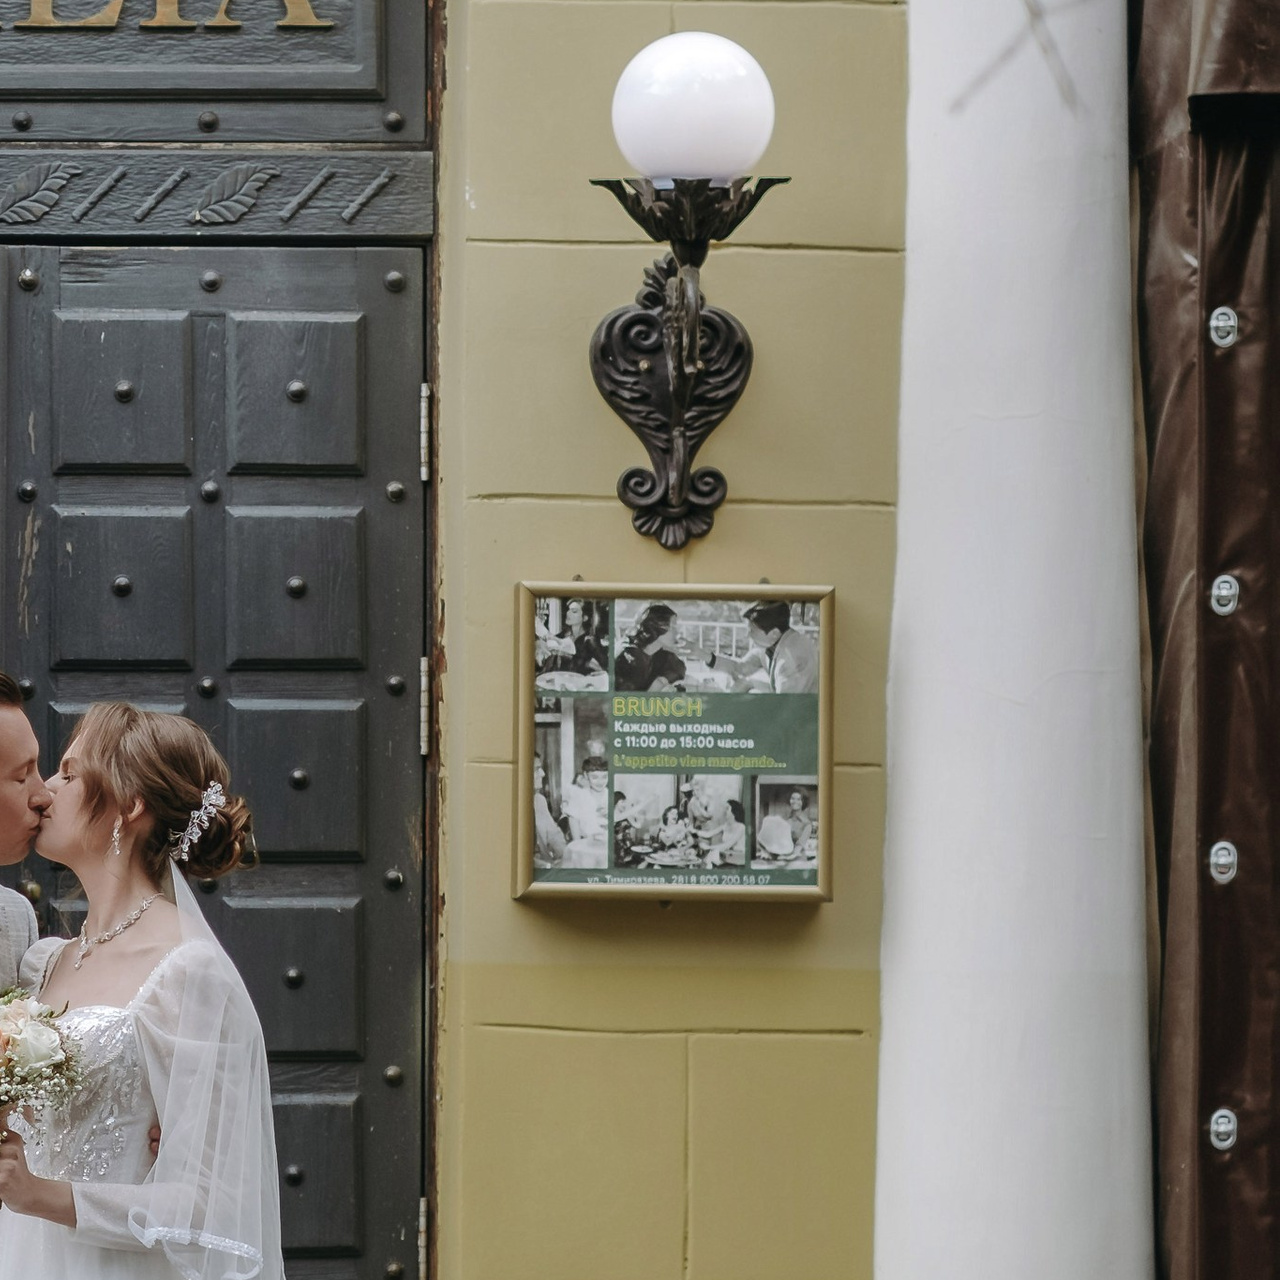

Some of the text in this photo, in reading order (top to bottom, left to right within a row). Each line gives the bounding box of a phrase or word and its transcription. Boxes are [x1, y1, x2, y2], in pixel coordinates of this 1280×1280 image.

[613, 697, 703, 717] BRUNCH
[614, 720, 735, 734] Каждые выходные
[614, 736, 754, 749] с 11:00 до 15:00 часов
